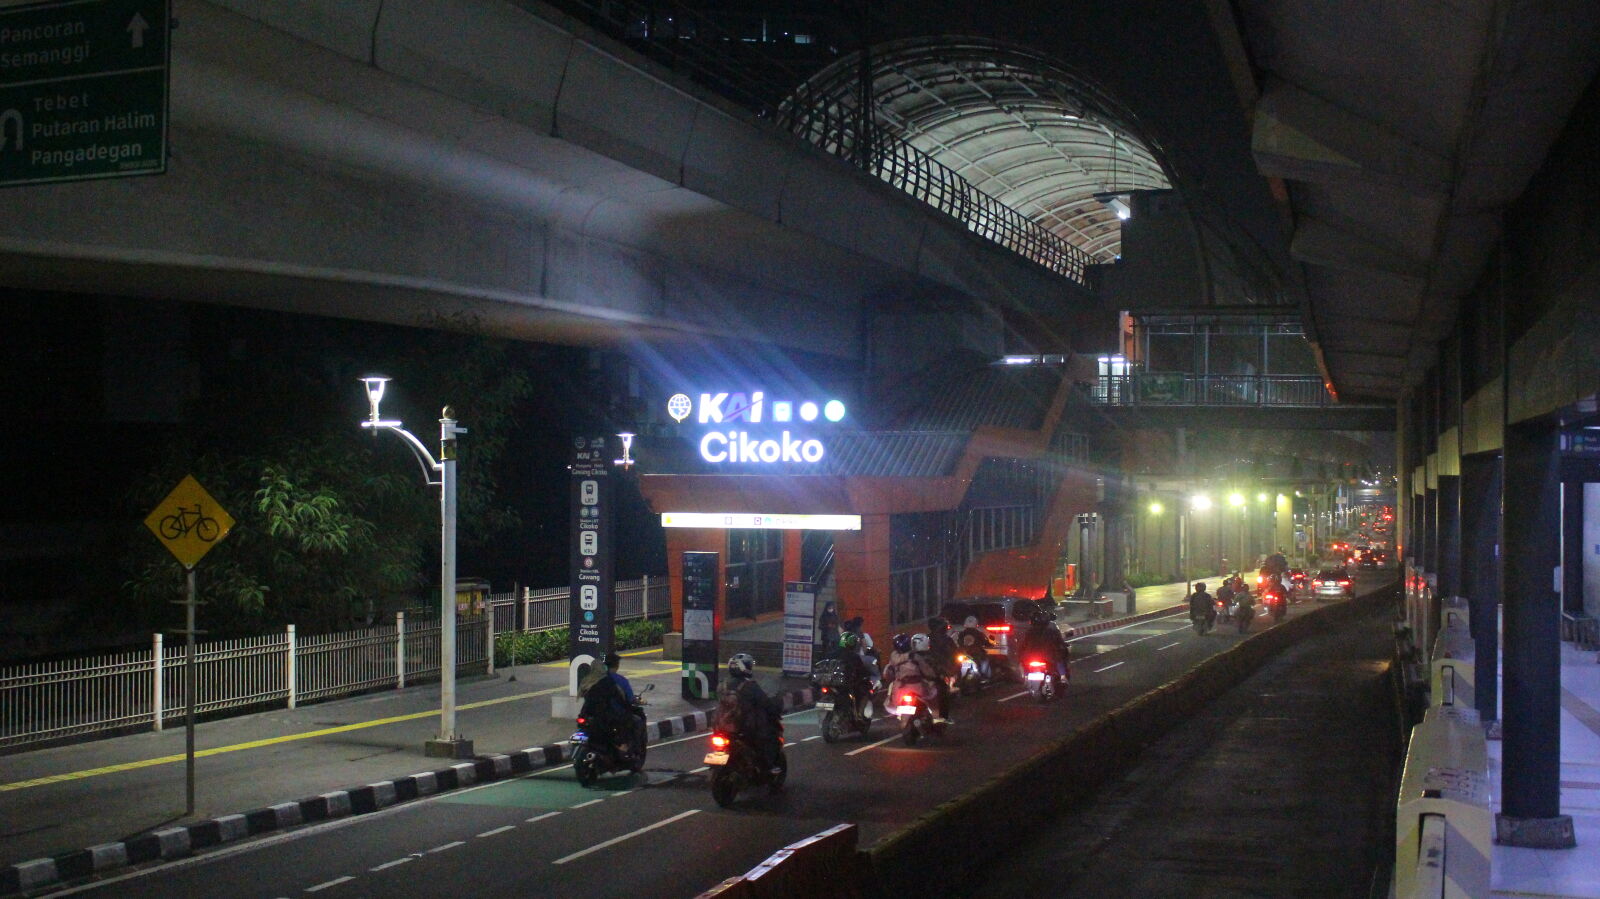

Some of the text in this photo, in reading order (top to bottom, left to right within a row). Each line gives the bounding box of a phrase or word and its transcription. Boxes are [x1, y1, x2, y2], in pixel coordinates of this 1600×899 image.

[1, 21, 85, 43] Pancoran
[33, 93, 89, 112] Tebet
[32, 111, 156, 138] Putaran Halim
[31, 143, 142, 167] Pangadegan
[700, 431, 824, 463] Cikoko
